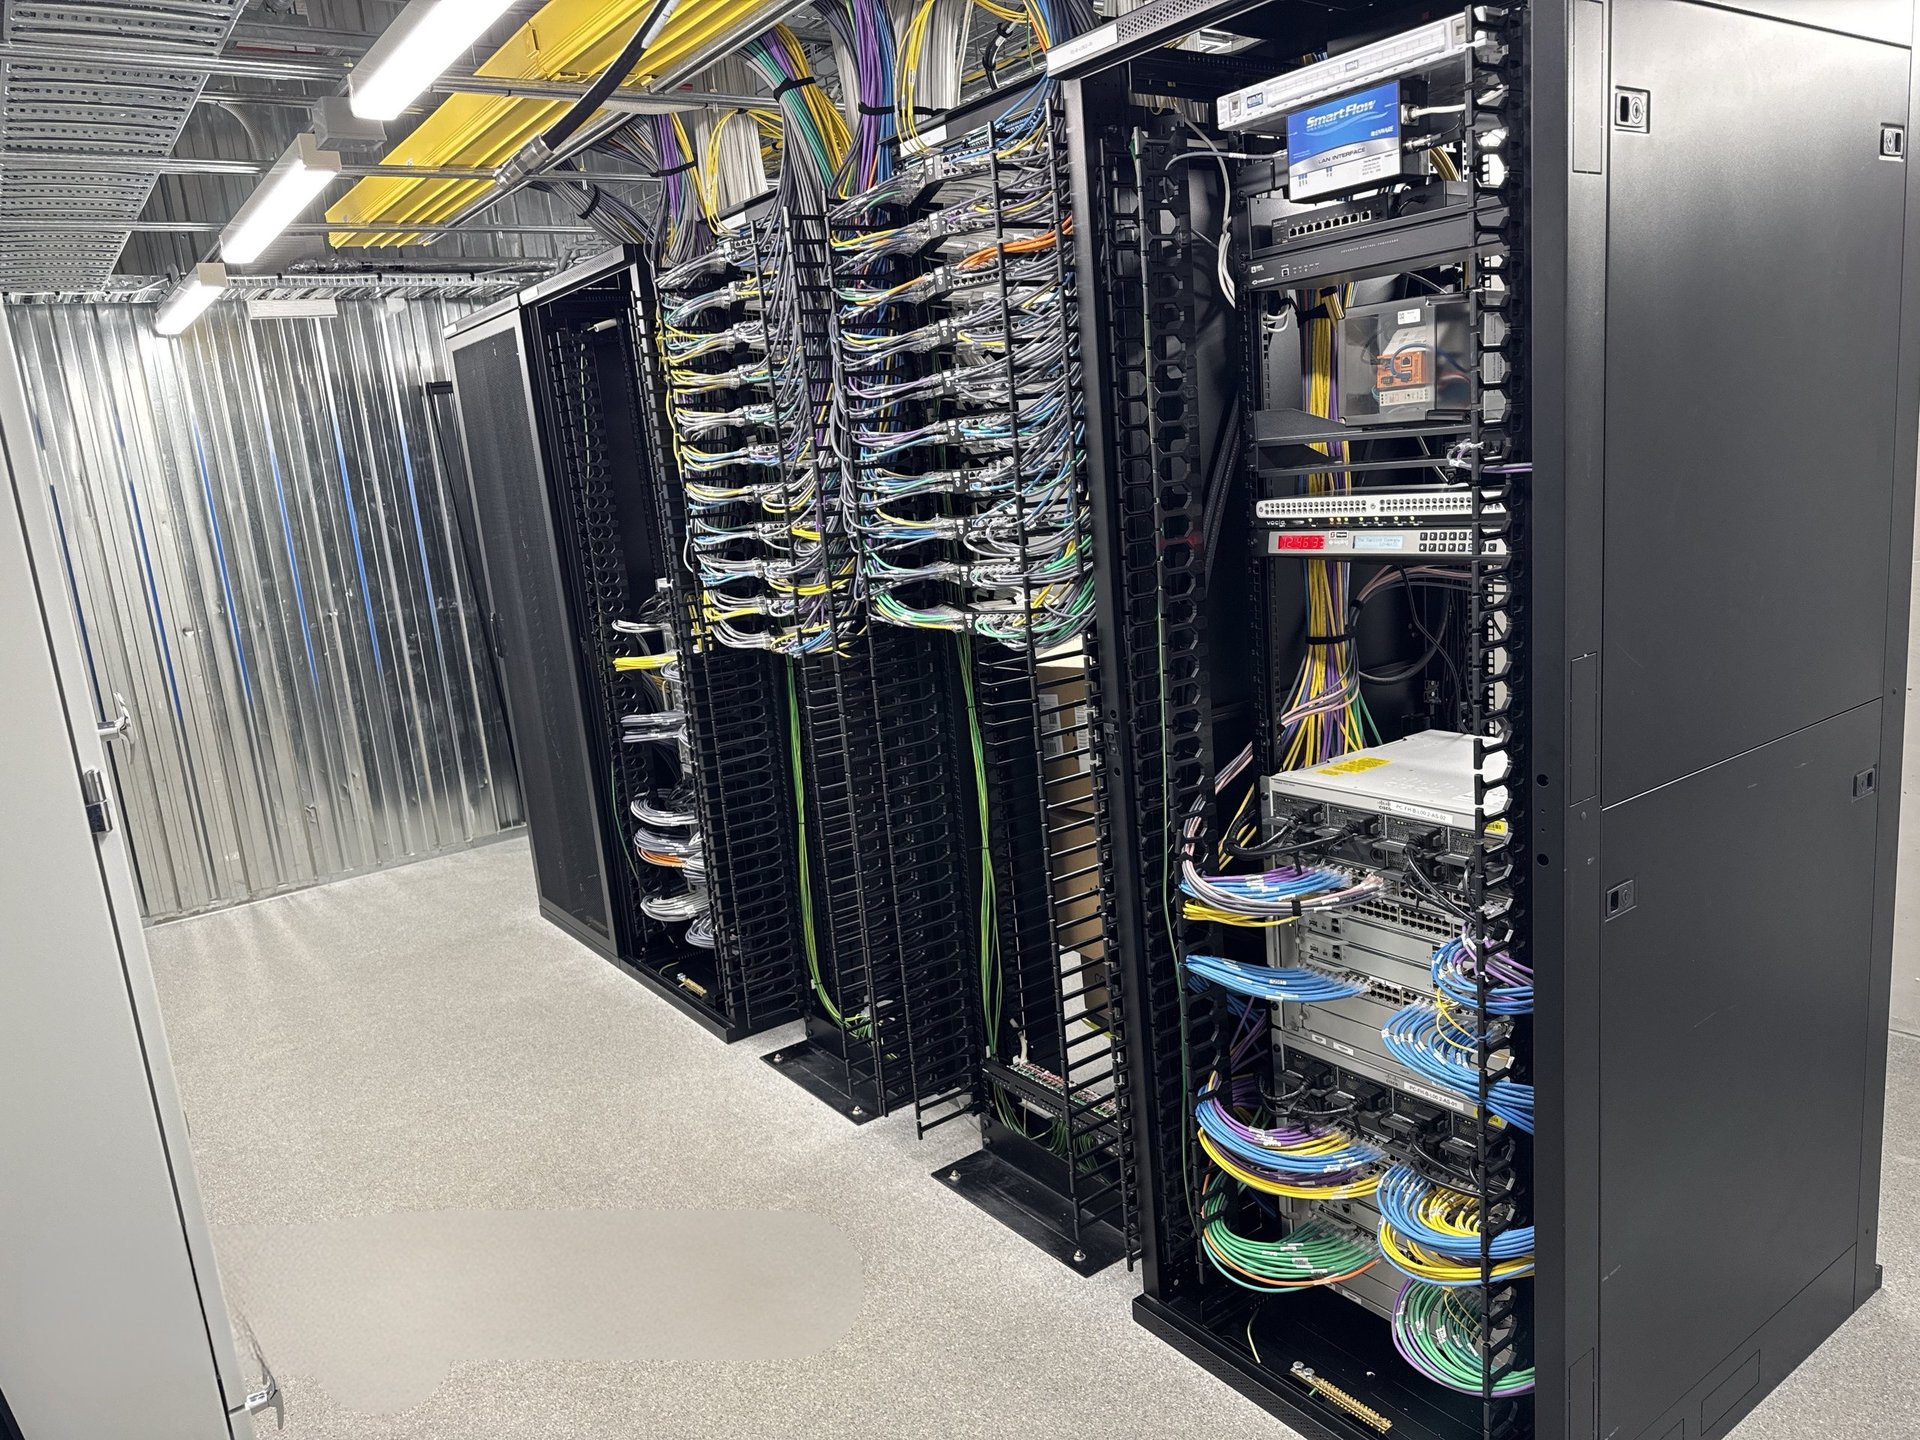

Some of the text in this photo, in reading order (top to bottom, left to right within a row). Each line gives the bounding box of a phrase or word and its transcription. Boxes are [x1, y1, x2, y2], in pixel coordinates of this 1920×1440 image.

[1306, 100, 1376, 128] SmartFlow
[1318, 147, 1366, 164] LAN INTERFACE
